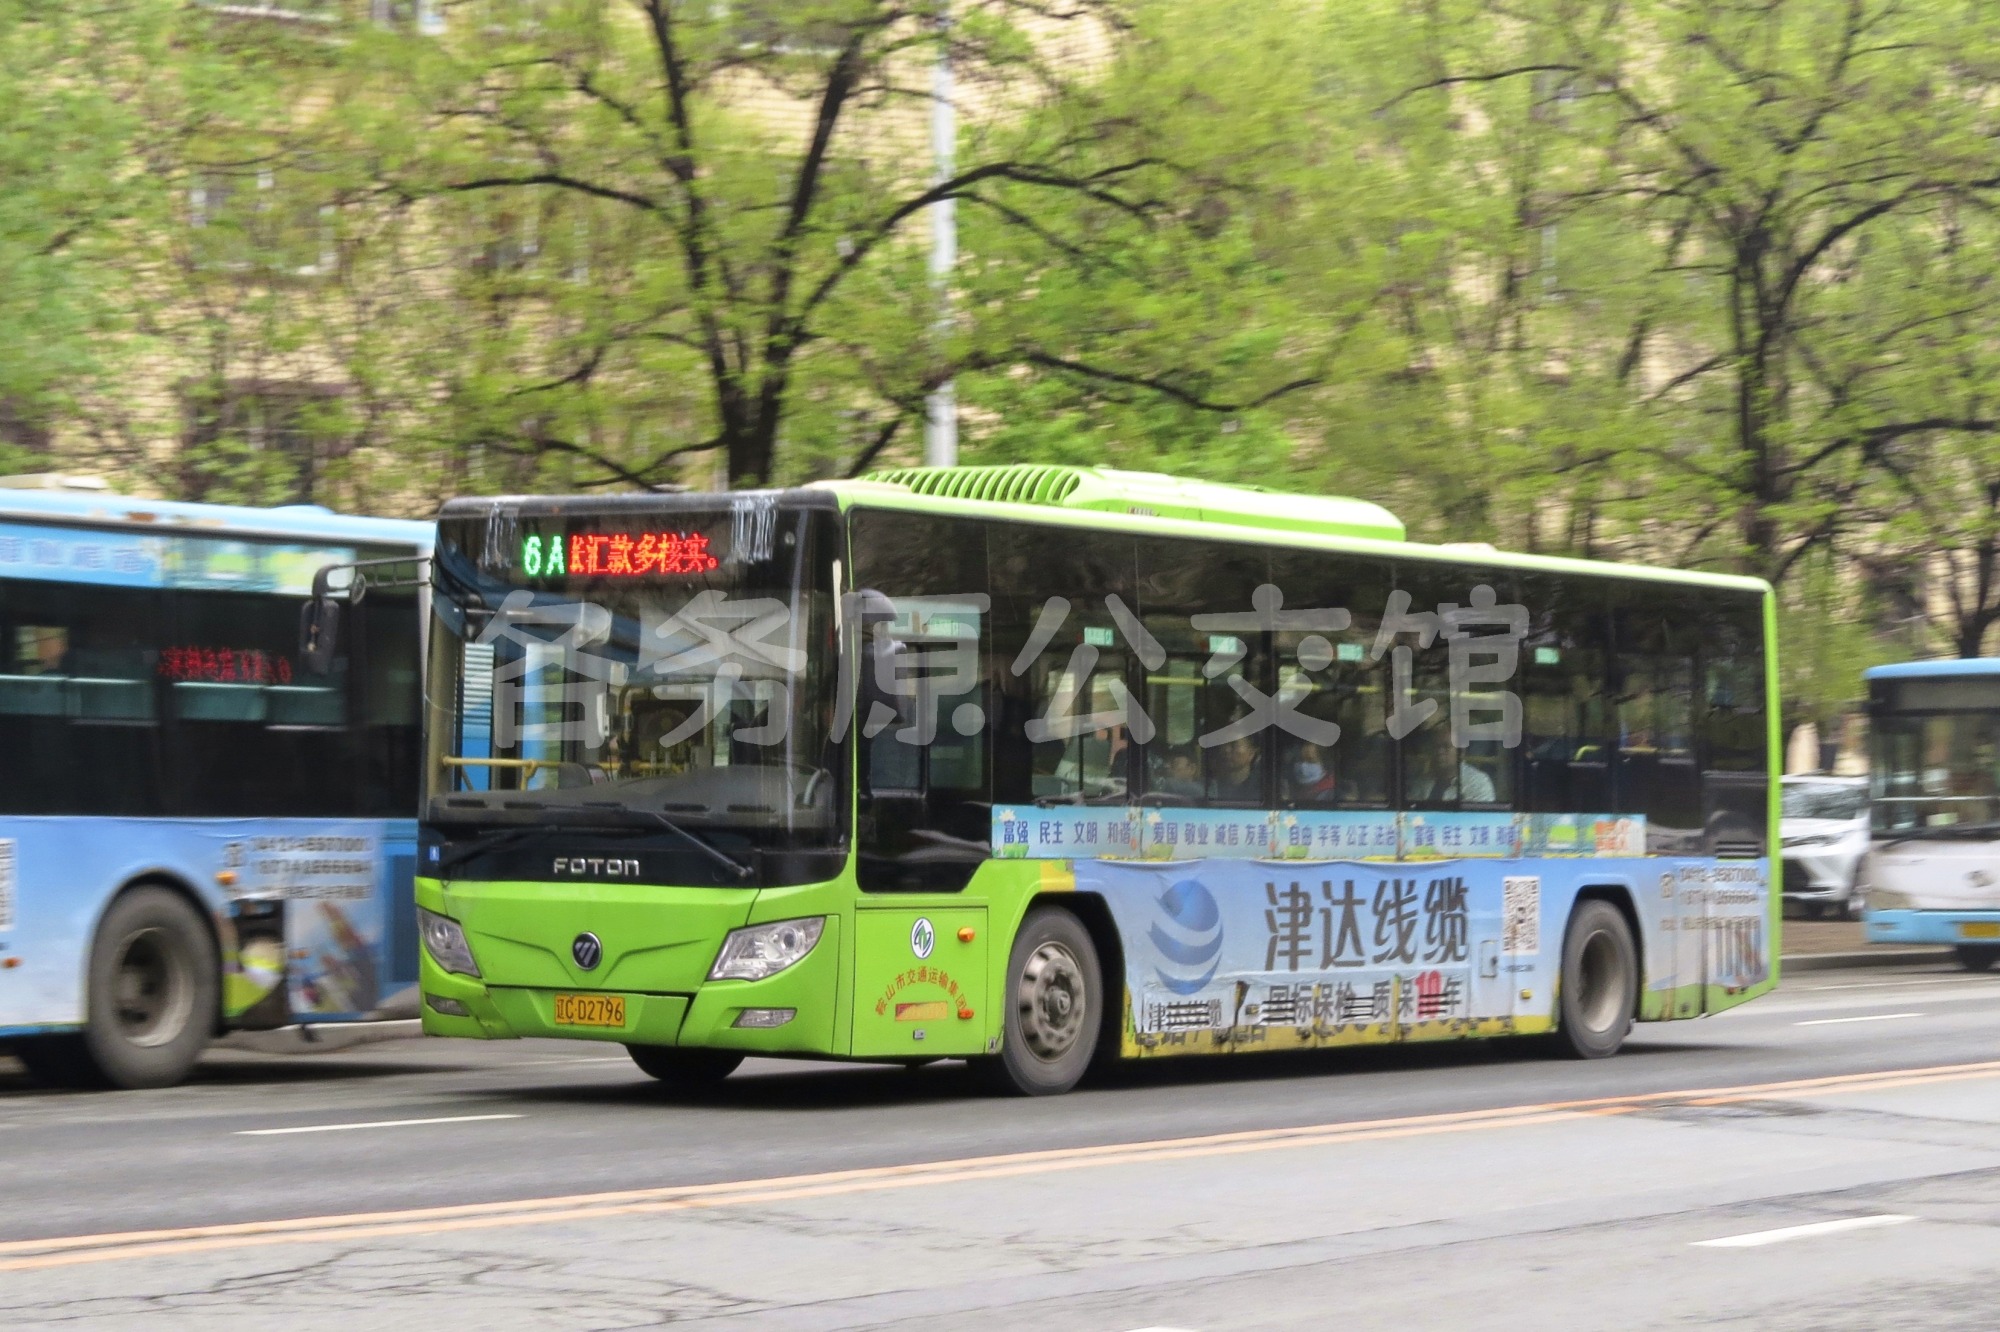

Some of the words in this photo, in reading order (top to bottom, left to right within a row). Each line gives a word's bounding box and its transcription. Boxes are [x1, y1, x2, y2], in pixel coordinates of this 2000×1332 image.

[524, 535, 565, 575] 6A
[1003, 820, 1028, 844] 富强
[1039, 820, 1064, 844] 民主
[1074, 821, 1098, 844] 文明
[1107, 821, 1131, 844] 和谐
[1153, 821, 1178, 845] 爱国
[1184, 822, 1208, 845] 敬业
[1215, 822, 1239, 846] 诚信
[1245, 823, 1269, 846] 友善
[553, 857, 640, 877] FOTON
[1264, 876, 1470, 972] 津达线缆
